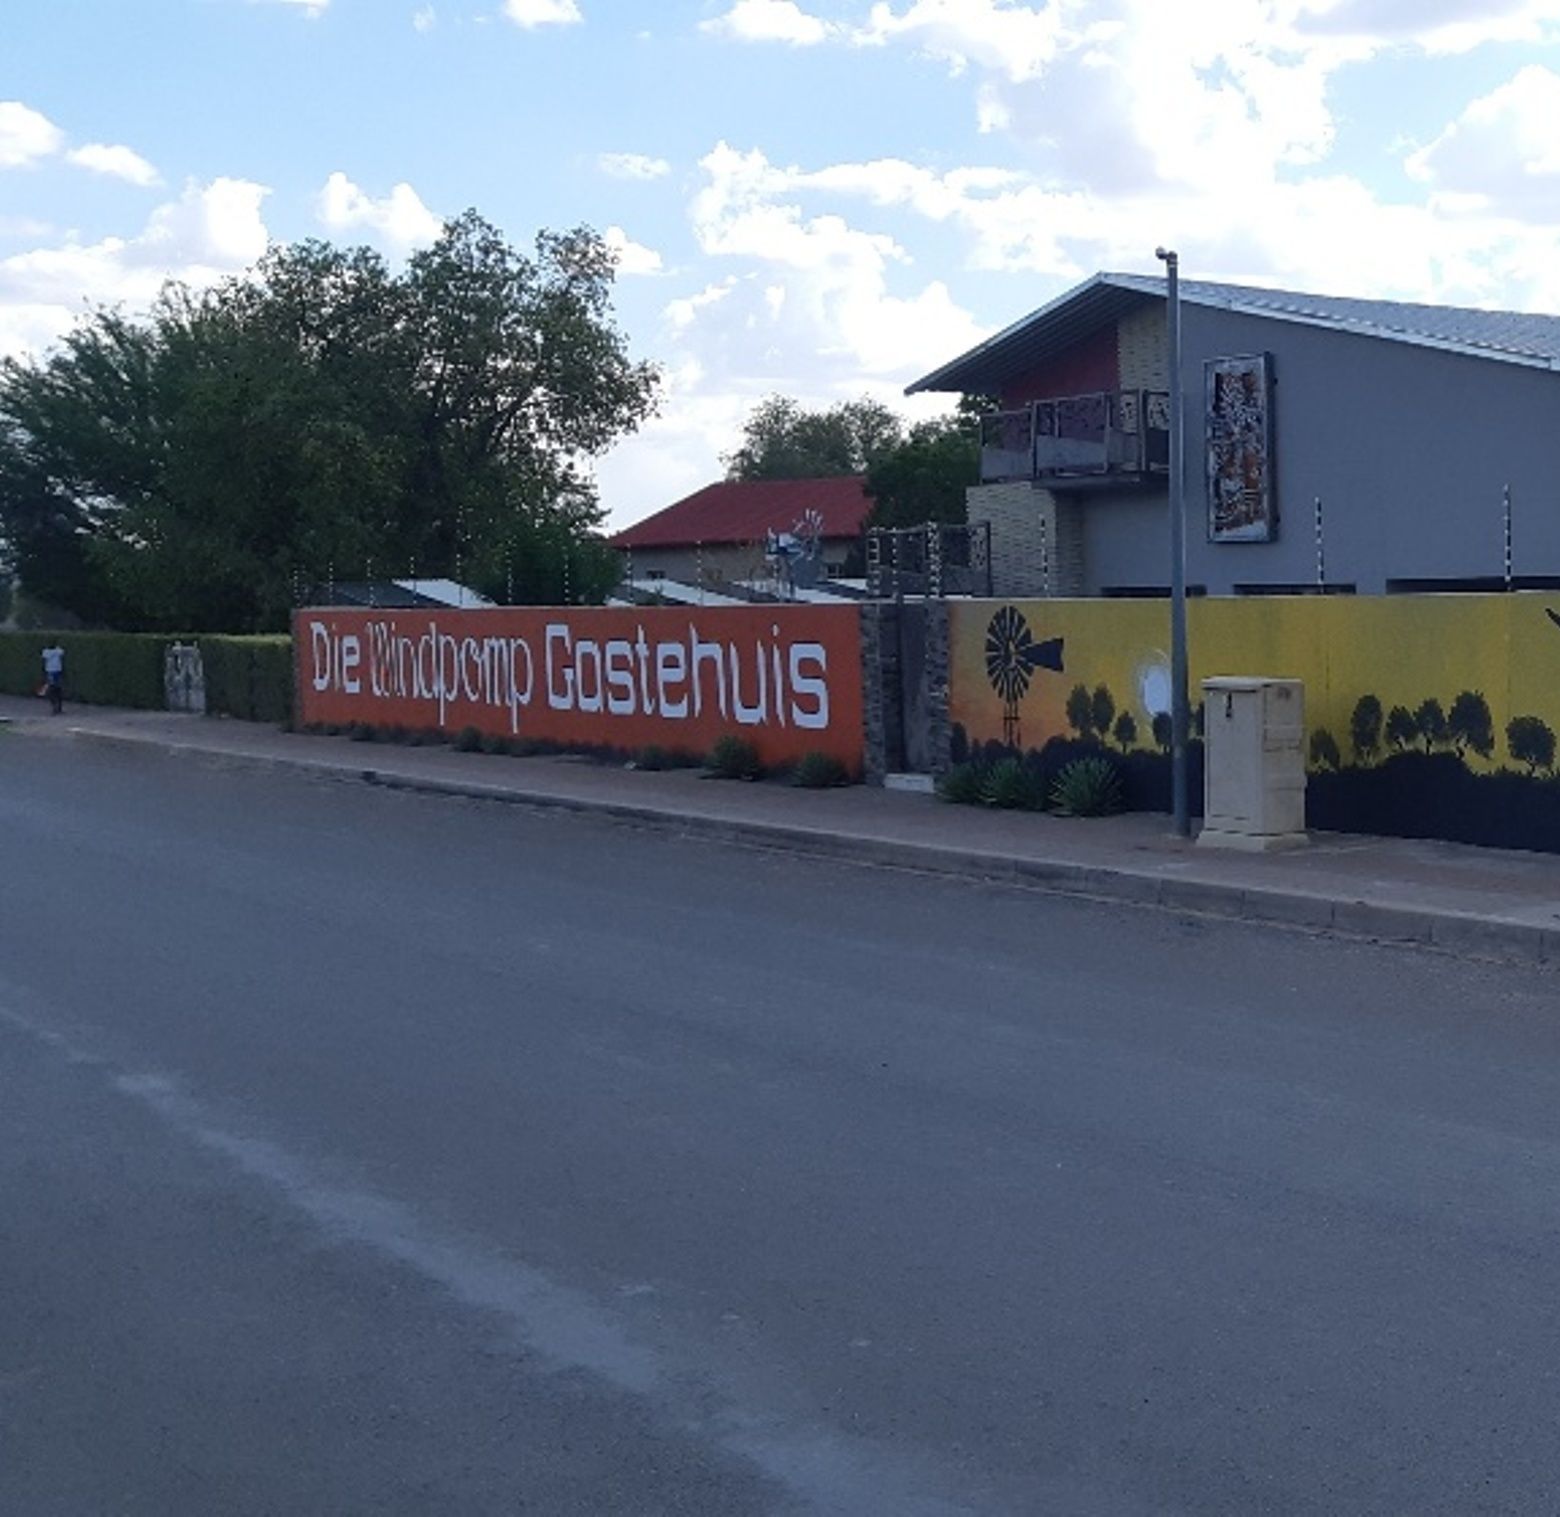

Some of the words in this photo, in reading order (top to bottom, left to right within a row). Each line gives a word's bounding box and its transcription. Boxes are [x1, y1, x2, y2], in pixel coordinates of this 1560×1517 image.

[310, 621, 361, 694] Die
[367, 621, 533, 734] Windpomp
[545, 622, 829, 729] Gastehuis
